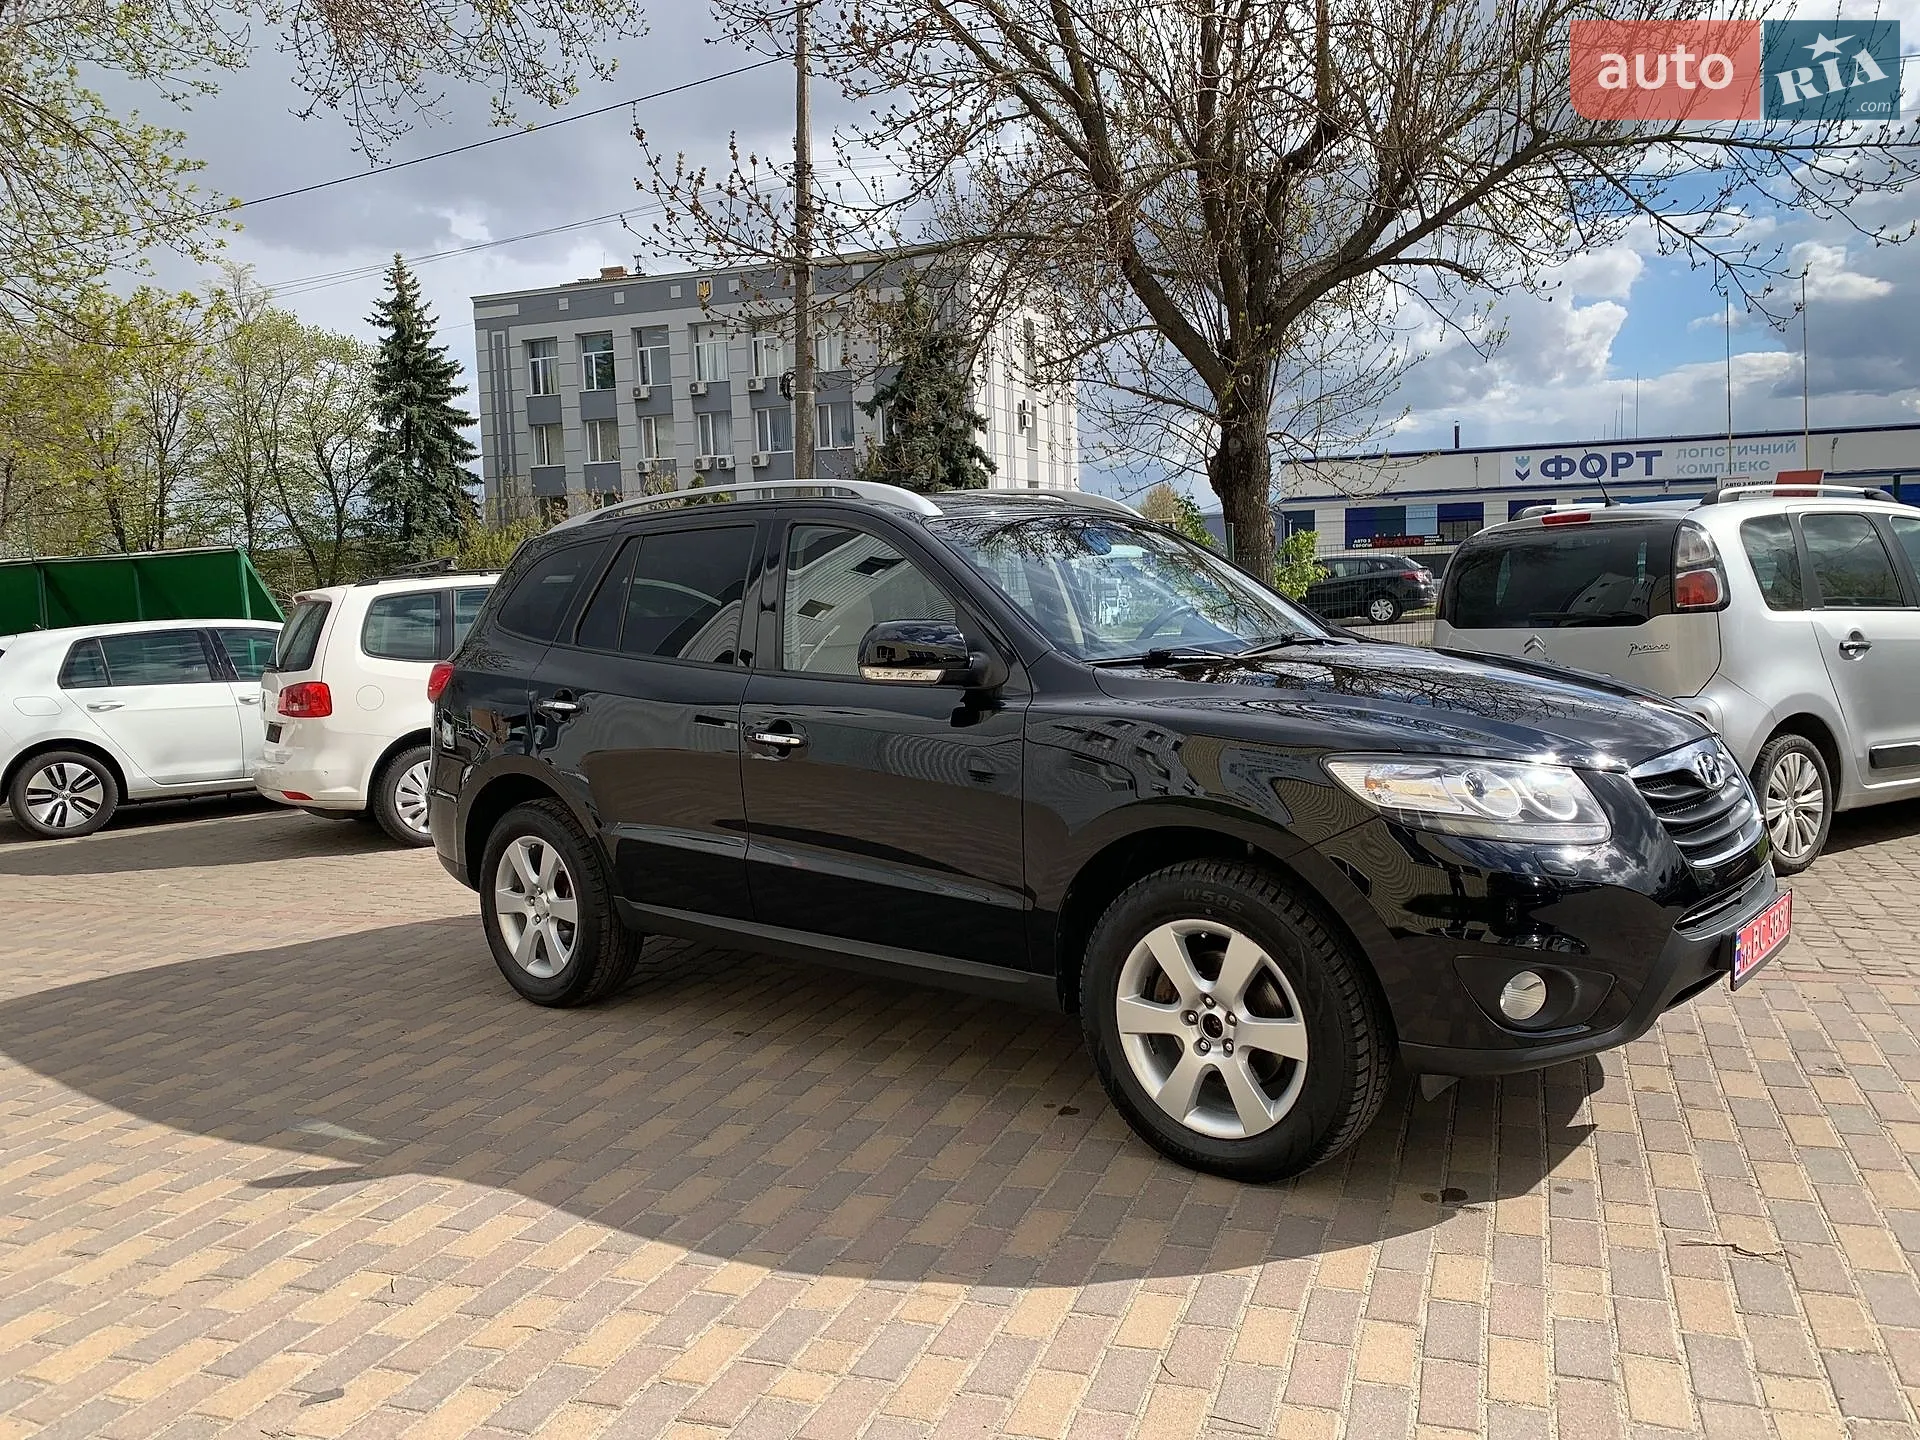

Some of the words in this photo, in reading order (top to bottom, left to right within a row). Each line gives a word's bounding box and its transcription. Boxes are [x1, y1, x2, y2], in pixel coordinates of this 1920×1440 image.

[1676, 440, 1796, 459] ЛОГІСТИЧНИЙ
[1540, 450, 1663, 480] ФОРТ
[1676, 461, 1770, 475] КОМПЛЕКС
